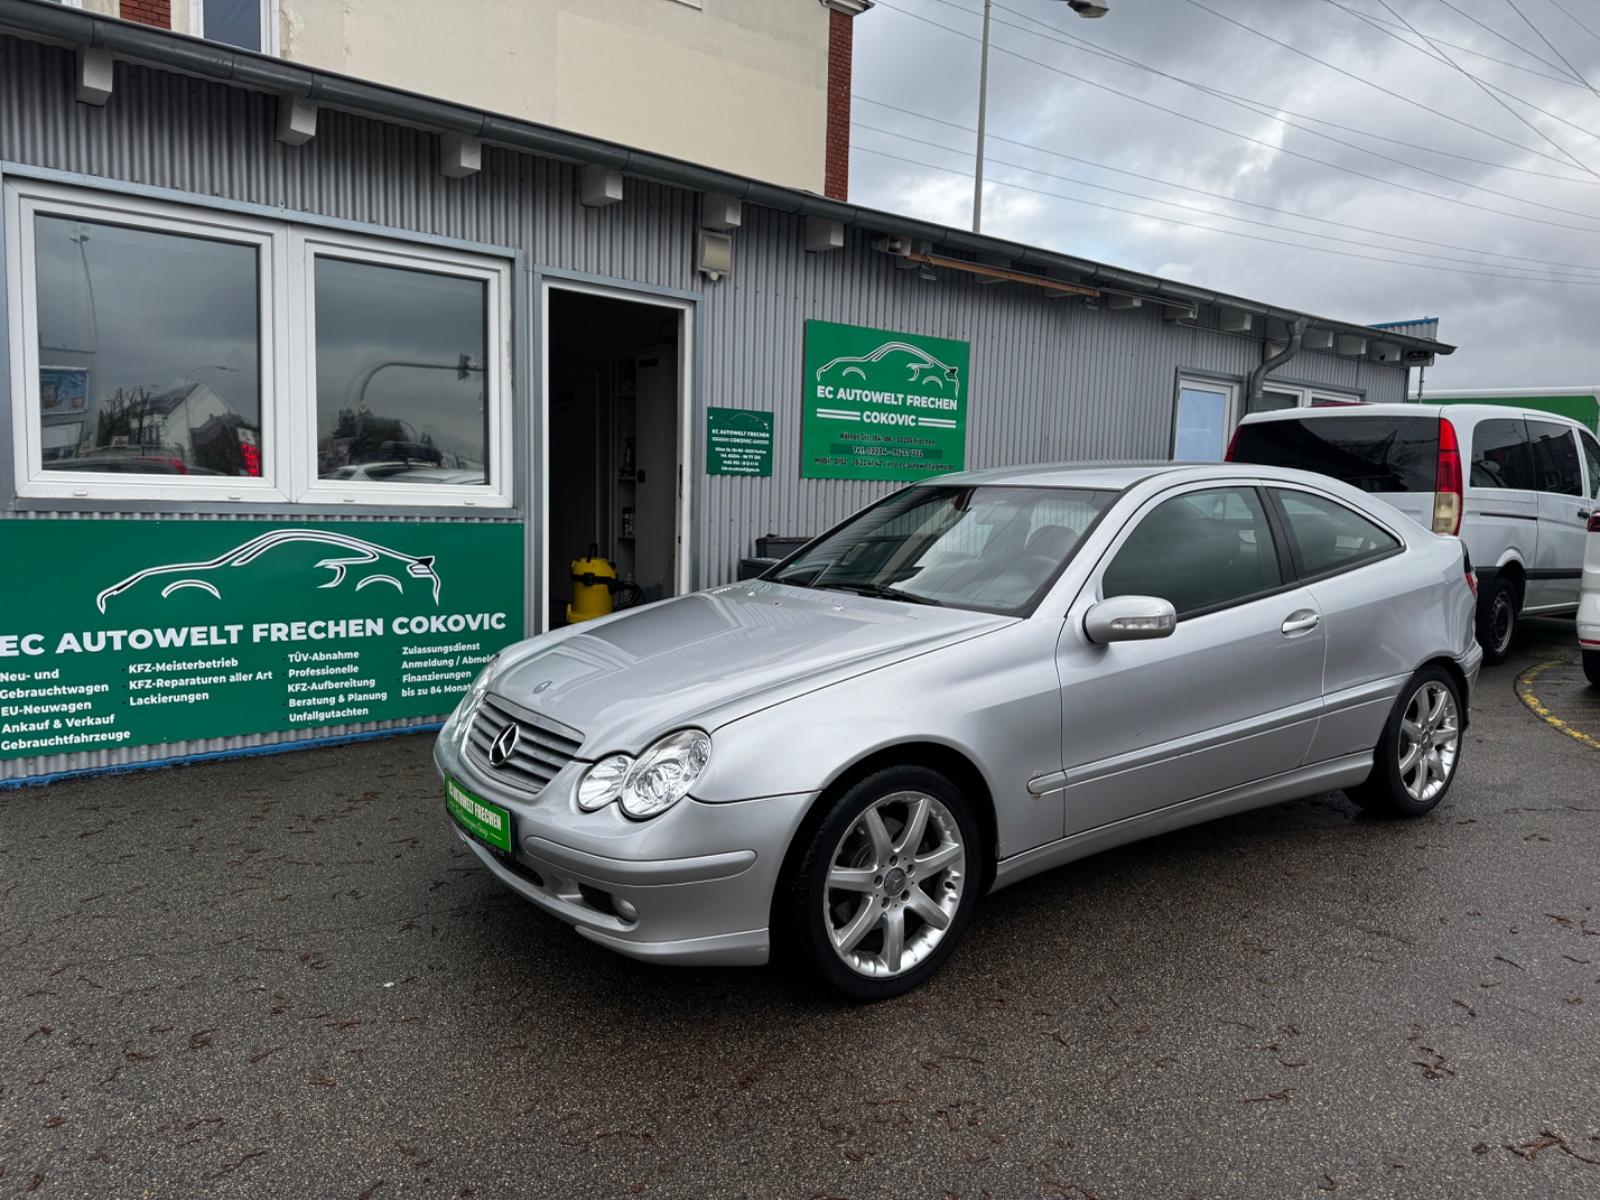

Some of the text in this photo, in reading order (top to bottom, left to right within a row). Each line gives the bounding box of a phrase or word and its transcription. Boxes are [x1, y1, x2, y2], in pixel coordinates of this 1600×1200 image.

[817, 385, 957, 411] EC AUTOWELT FRECHEN
[862, 411, 916, 427] COKOVIC
[0, 612, 507, 657] EC AUTOWELT FRECHEN COKOVIC
[288, 650, 360, 663] TÜV-Abnahme
[402, 642, 480, 655] Zulassungsdienst
[128, 657, 239, 674] KFZ-Meisterbetrieb
[288, 665, 359, 678] Professionelle
[401, 658, 454, 669] Anmeldung
[0, 668, 60, 682] Neu- und
[129, 671, 273, 691] KFZ-Reparaturen aller Art
[402, 670, 472, 683] Finanzierungen
[0, 683, 109, 700] Gebrauchtwagen
[288, 678, 376, 693] KFZ-Aufbereitung
[401, 688, 415, 697] bis
[417, 688, 428, 696] zu
[430, 687, 442, 695] 84
[130, 691, 209, 707] Lackierungen
[288, 692, 388, 708] Beratung & Planung
[1, 700, 92, 717] EU-Neuwagen
[289, 707, 369, 722] Unfallgutachten
[1, 714, 115, 734] Ankauf & Verkauf
[1, 729, 131, 751] Gebrauchtfahrzeuge
